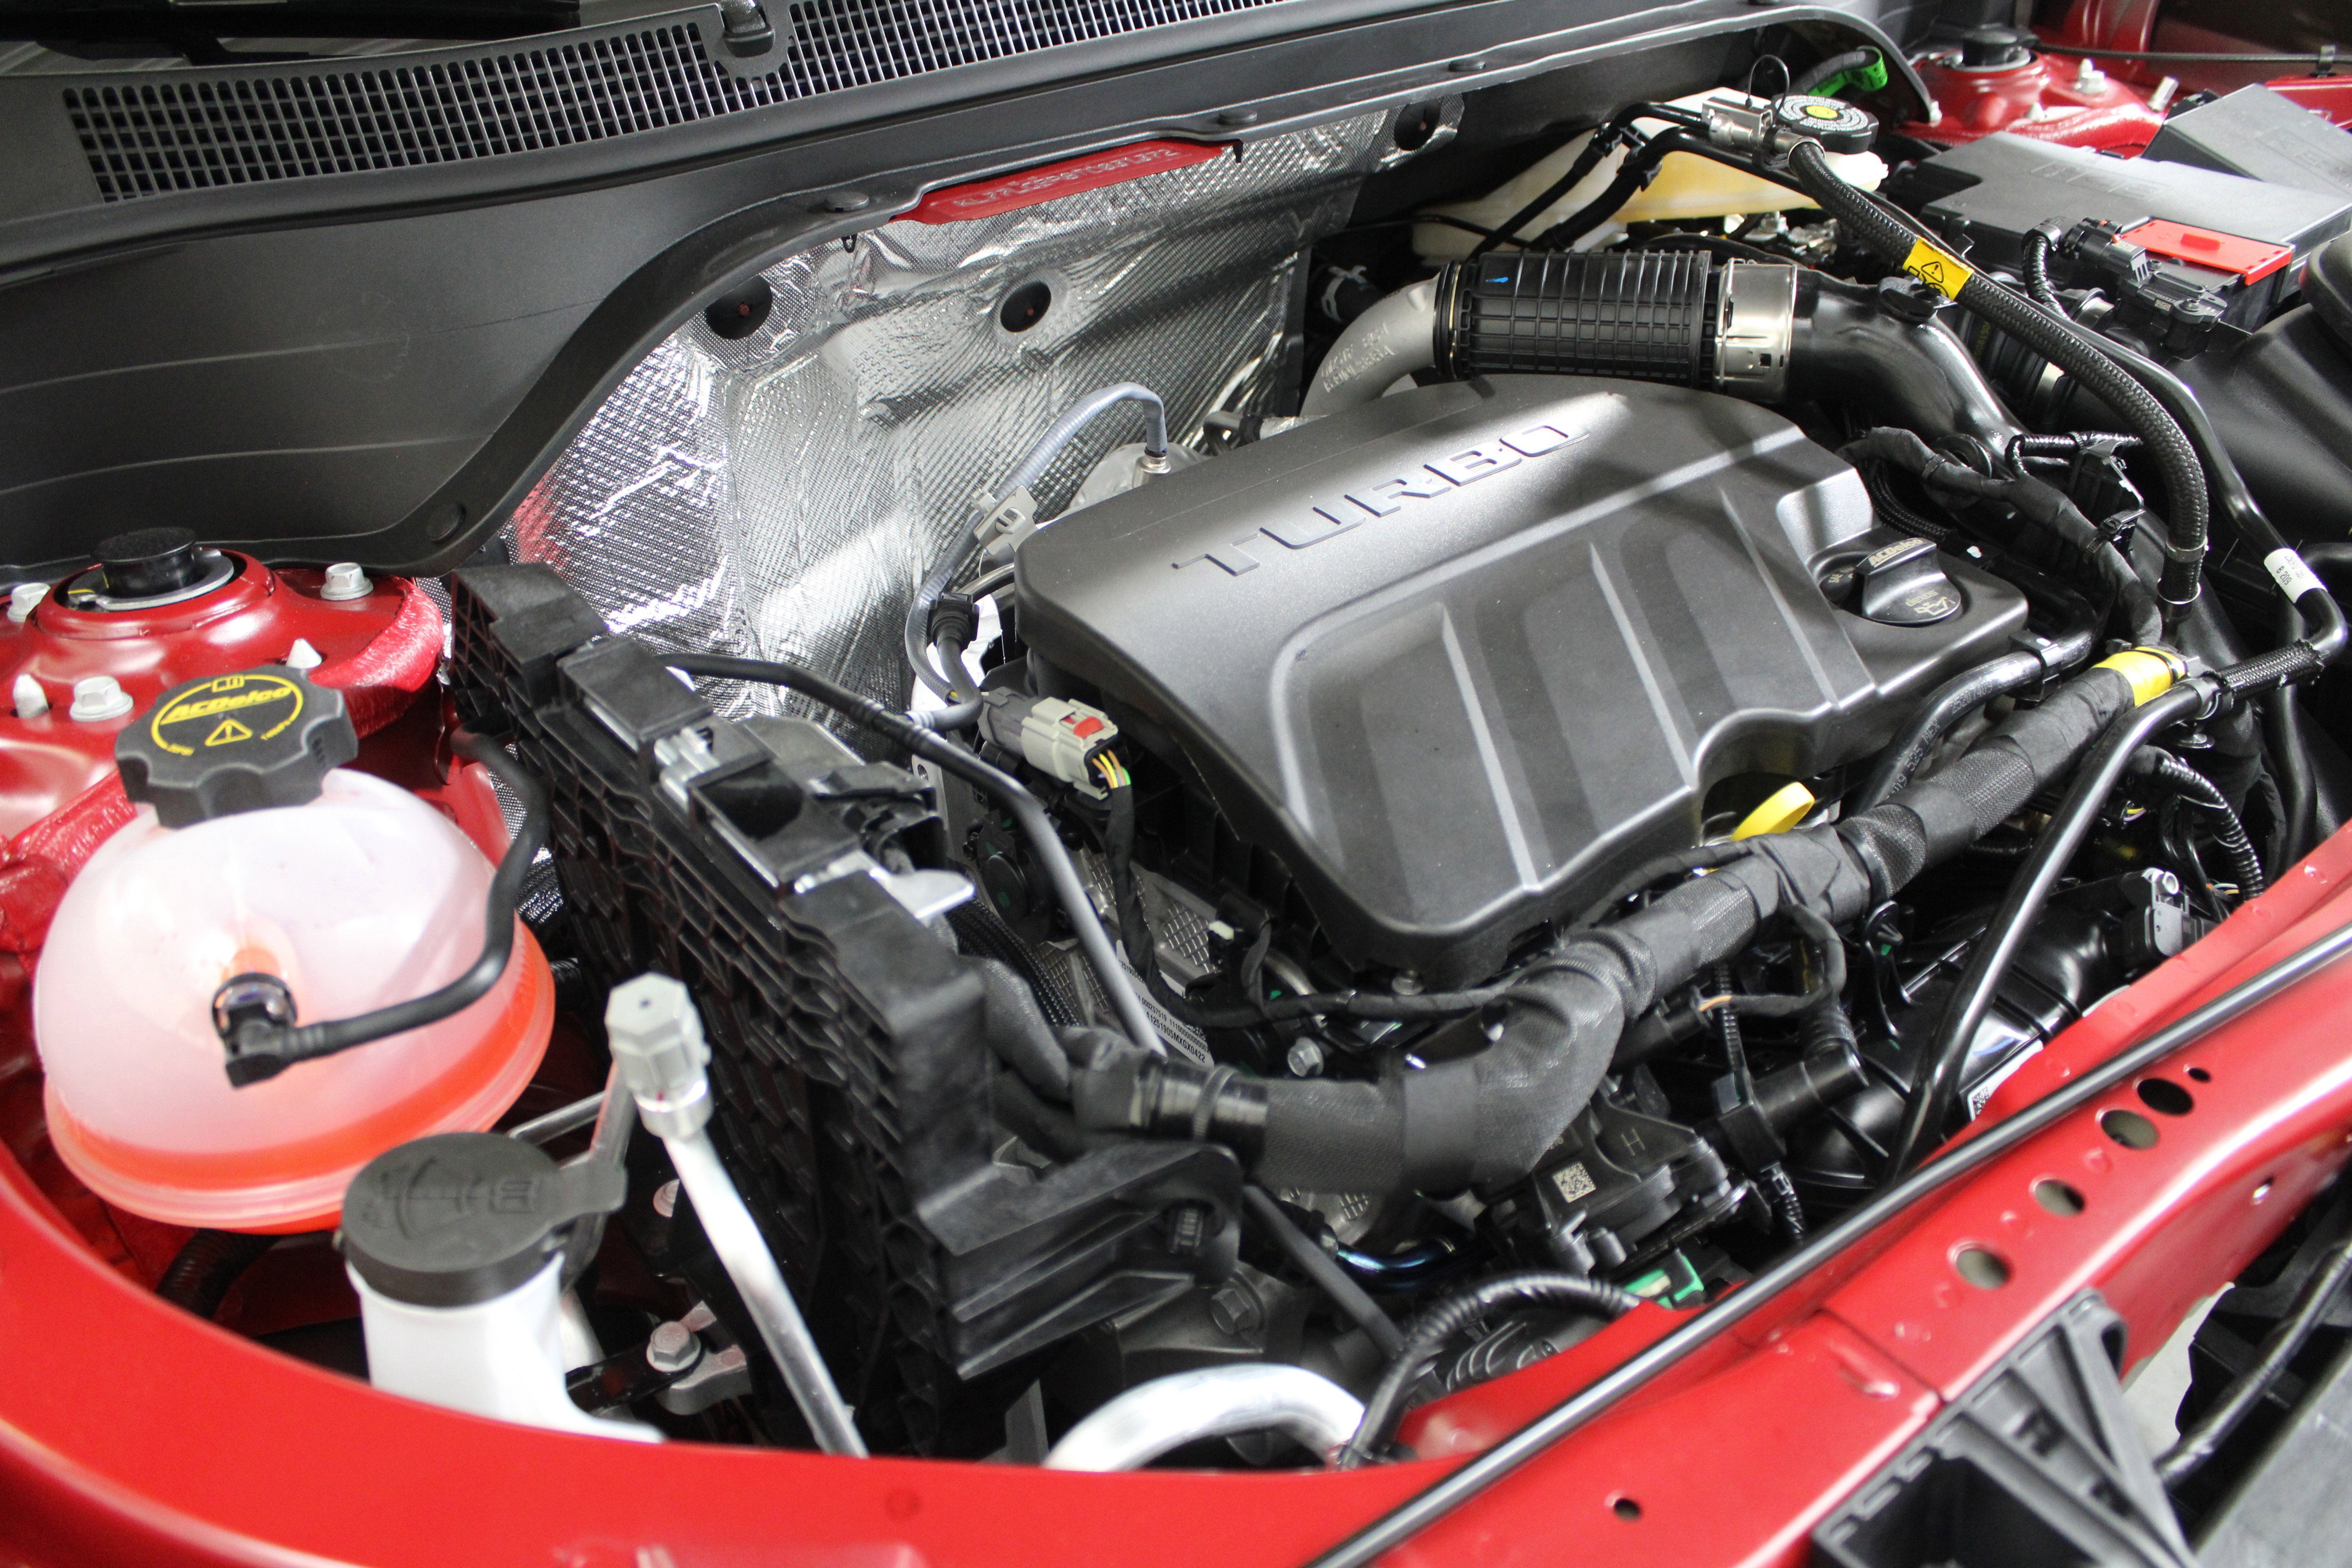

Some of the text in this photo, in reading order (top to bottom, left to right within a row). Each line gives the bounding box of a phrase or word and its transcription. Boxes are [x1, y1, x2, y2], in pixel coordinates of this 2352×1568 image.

[1171, 417, 1590, 576] TURBO
[1869, 539, 1924, 566] ACDelco
[2276, 566, 2292, 585] B 209
[1905, 590, 1938, 606] dexos
[167, 686, 292, 721] ACDelco
